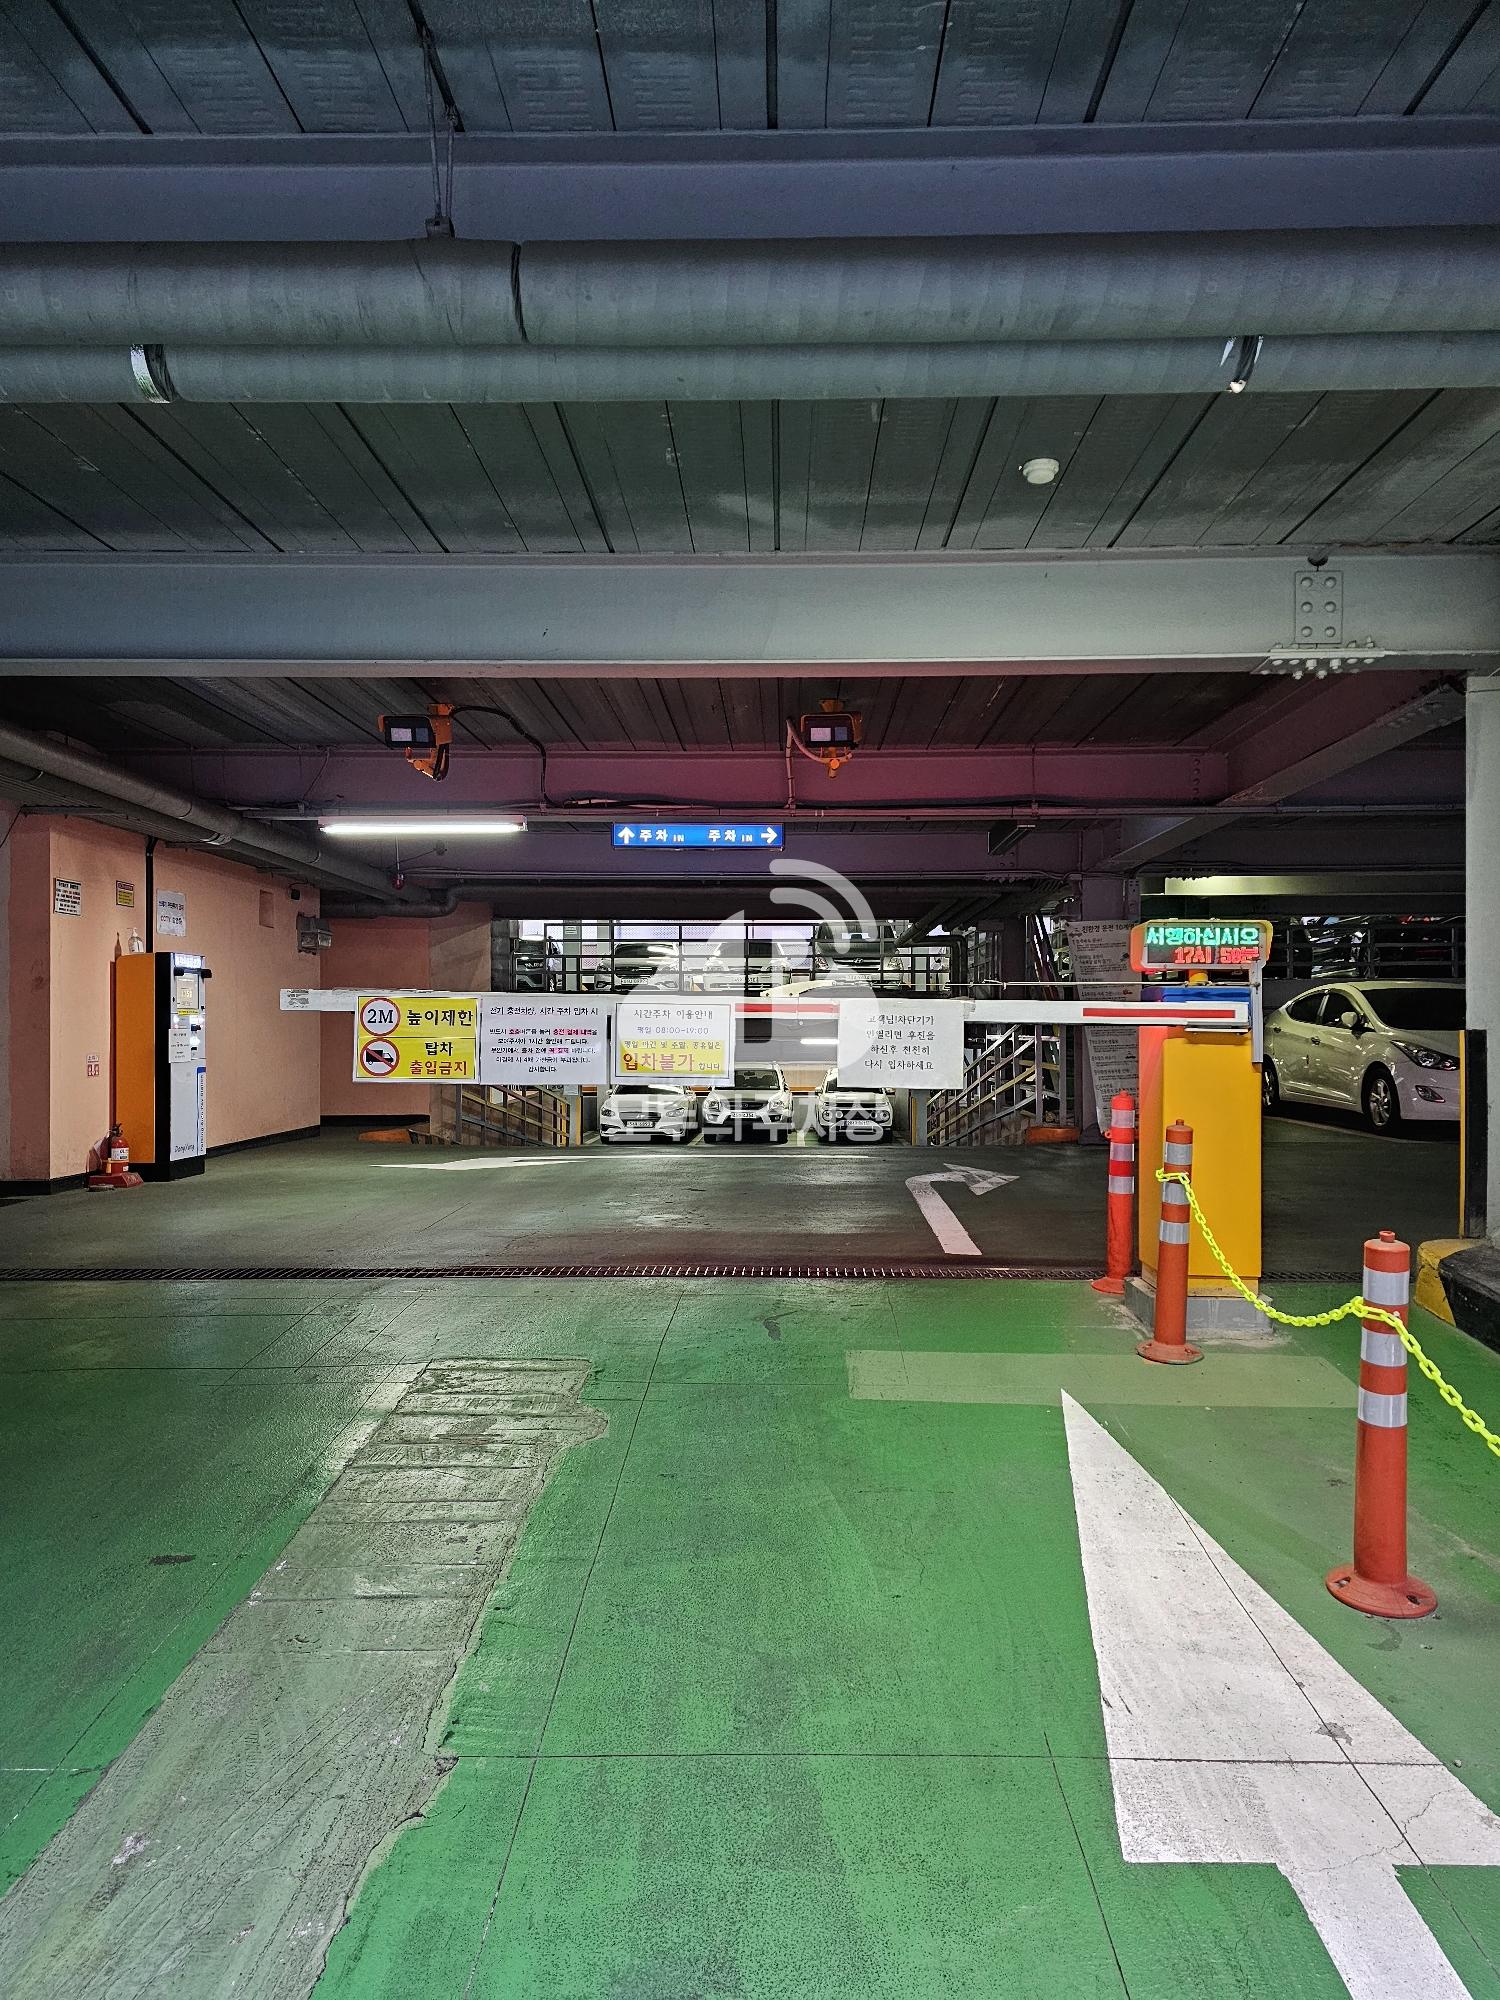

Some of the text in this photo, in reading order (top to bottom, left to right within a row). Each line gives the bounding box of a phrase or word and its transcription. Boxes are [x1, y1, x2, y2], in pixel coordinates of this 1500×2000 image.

[639, 829, 685, 842] 주차 IN
[708, 829, 753, 842] 주차 IN
[1146, 926, 1259, 945] 서행하십시오
[1174, 946, 1212, 964] 17시
[367, 1008, 394, 1024] 2M
[407, 1010, 474, 1026] 높이제한
[540, 1006, 555, 1016] 시간
[557, 1006, 571, 1016] 주차
[573, 1006, 588, 1016] 입차
[591, 1006, 598, 1016] 시
[633, 1009, 713, 1020] 시간주차 이용안내
[907, 1030, 935, 1040] 후진을
[424, 1041, 453, 1056] 탑차
[870, 1044, 930, 1055] 하신후 천천히
[409, 1060, 467, 1075] 출입금지
[623, 1053, 720, 1072] 입차불가 합니다
[864, 1060, 934, 1070] 다시 입차하세요
